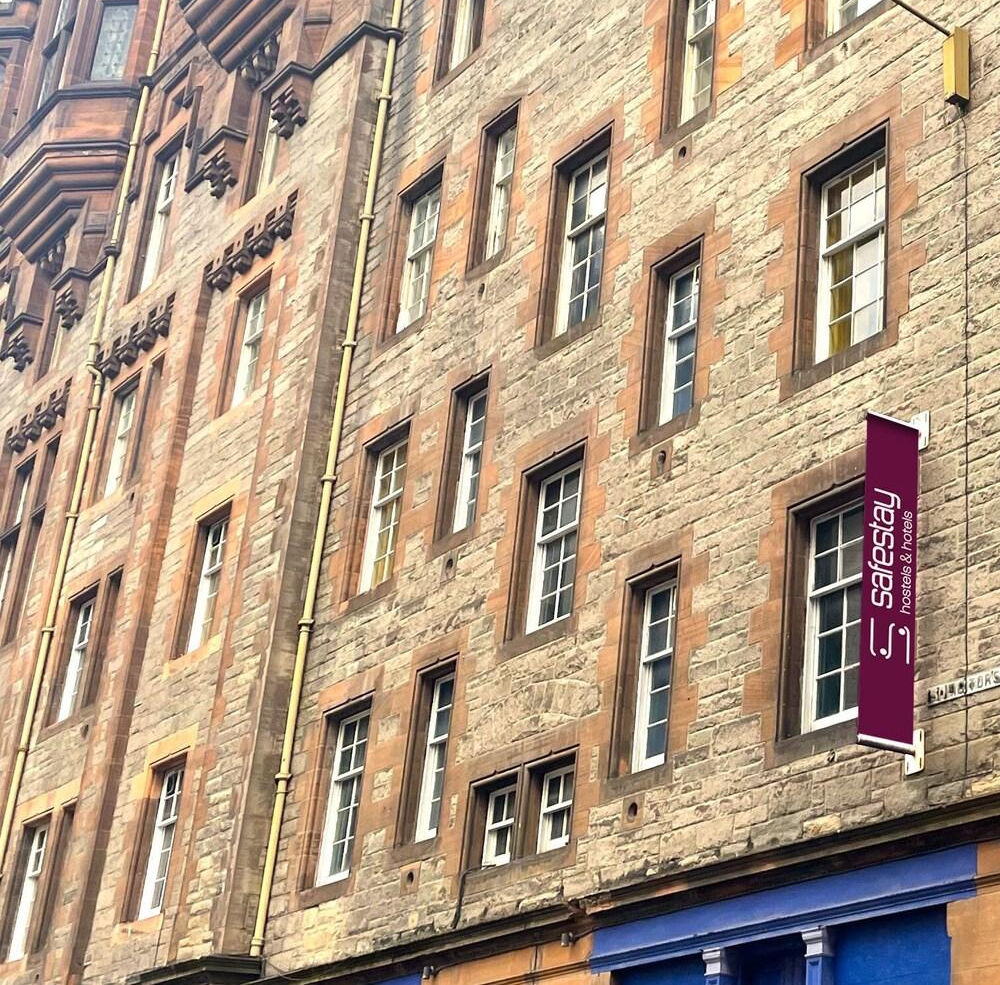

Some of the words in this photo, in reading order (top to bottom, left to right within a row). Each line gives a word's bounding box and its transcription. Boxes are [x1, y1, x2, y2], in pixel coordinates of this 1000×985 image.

[867, 487, 901, 609] safestay
[901, 510, 913, 551] hotels
[900, 554, 912, 564] &
[900, 565, 912, 615] hostels
